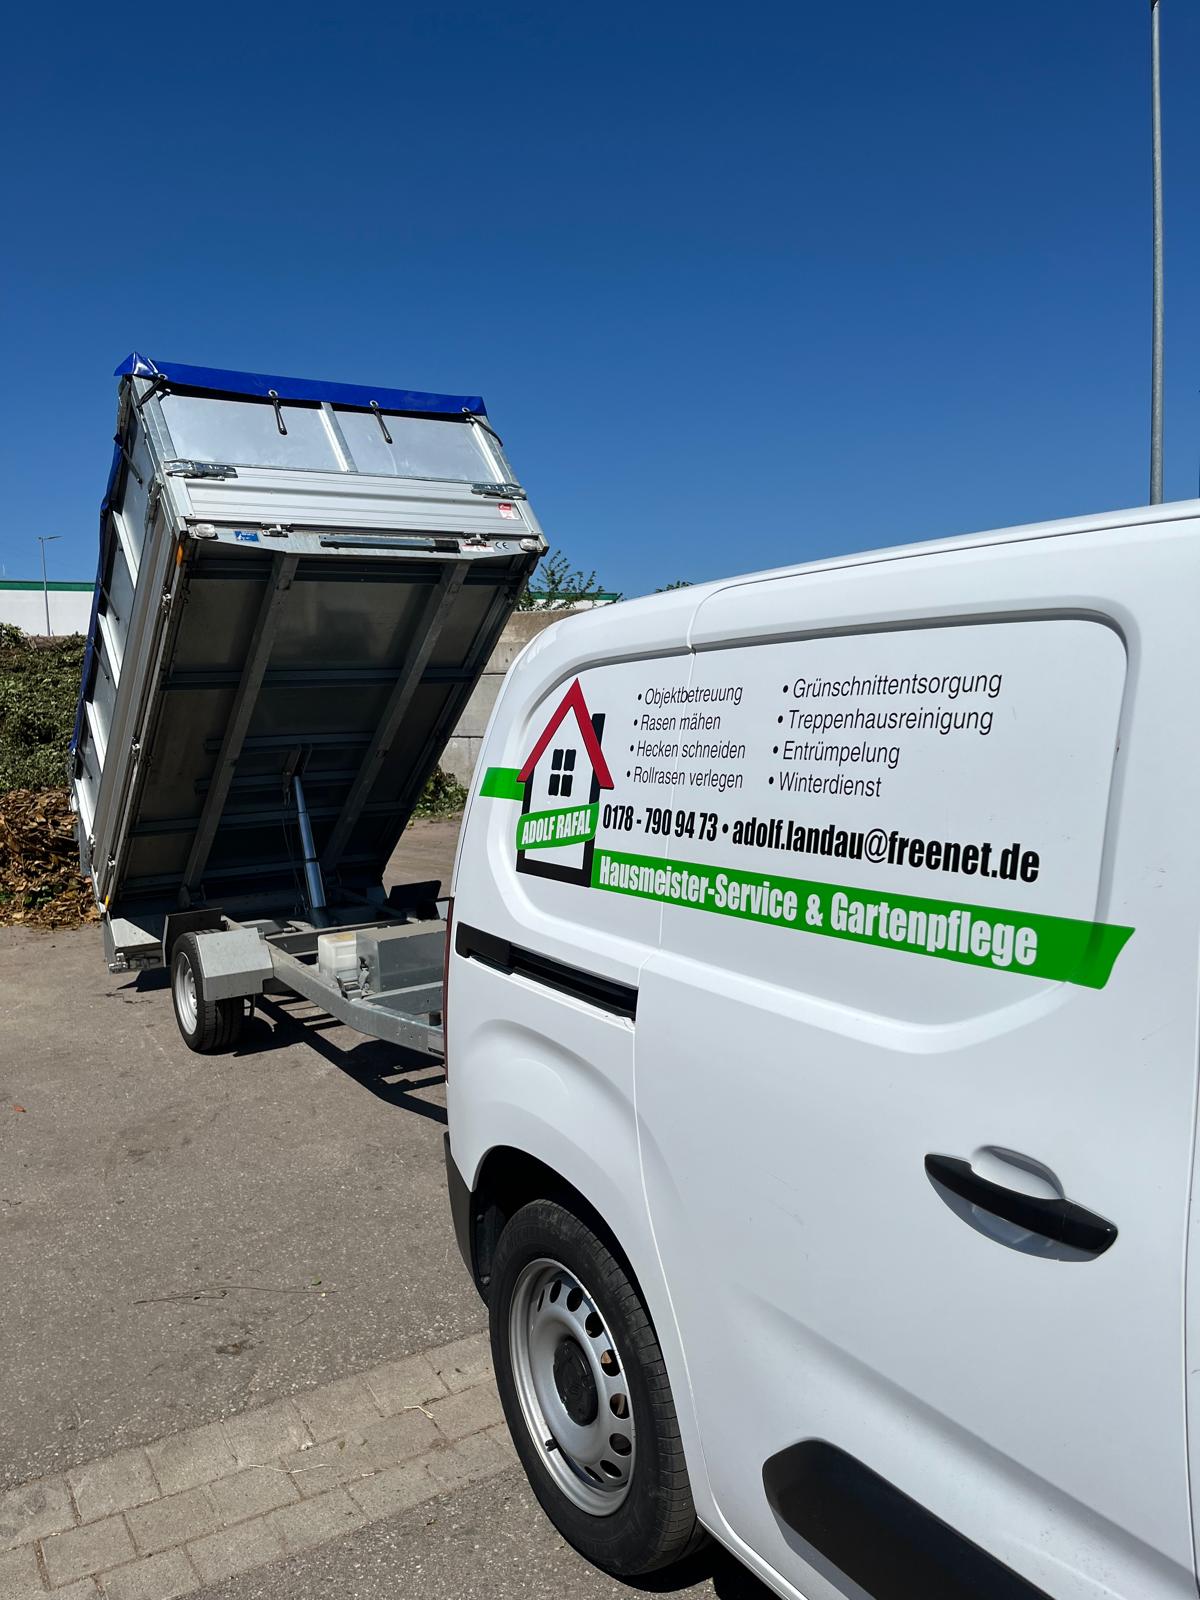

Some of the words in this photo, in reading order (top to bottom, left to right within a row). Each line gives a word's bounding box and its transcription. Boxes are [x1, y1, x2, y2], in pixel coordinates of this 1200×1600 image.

[645, 686, 743, 707] Objektbetreuung
[794, 673, 1002, 698] Grünschnittentsorgung
[641, 714, 676, 731] Rasen
[679, 712, 721, 731] mähen
[789, 707, 993, 735] Treppenhausreinigung
[637, 741, 678, 758] Hecken
[682, 741, 746, 759] schneiden
[783, 740, 900, 769] Entrümpelung
[633, 767, 686, 785] Rollrasen
[689, 772, 743, 792] verlegen
[779, 772, 882, 797] Winterdienst
[523, 814, 554, 845] ADOLF
[556, 808, 591, 840] RAFAL
[603, 802, 634, 832] 0178
[645, 808, 672, 836] 790
[675, 810, 696, 839] 94
[699, 813, 718, 842] 73
[733, 816, 1040, 883] adolf.landau@freenet.de
[599, 855, 798, 921] Hausmeister-Service
[805, 894, 824, 927] &
[830, 892, 1038, 967] Gartenpflege
